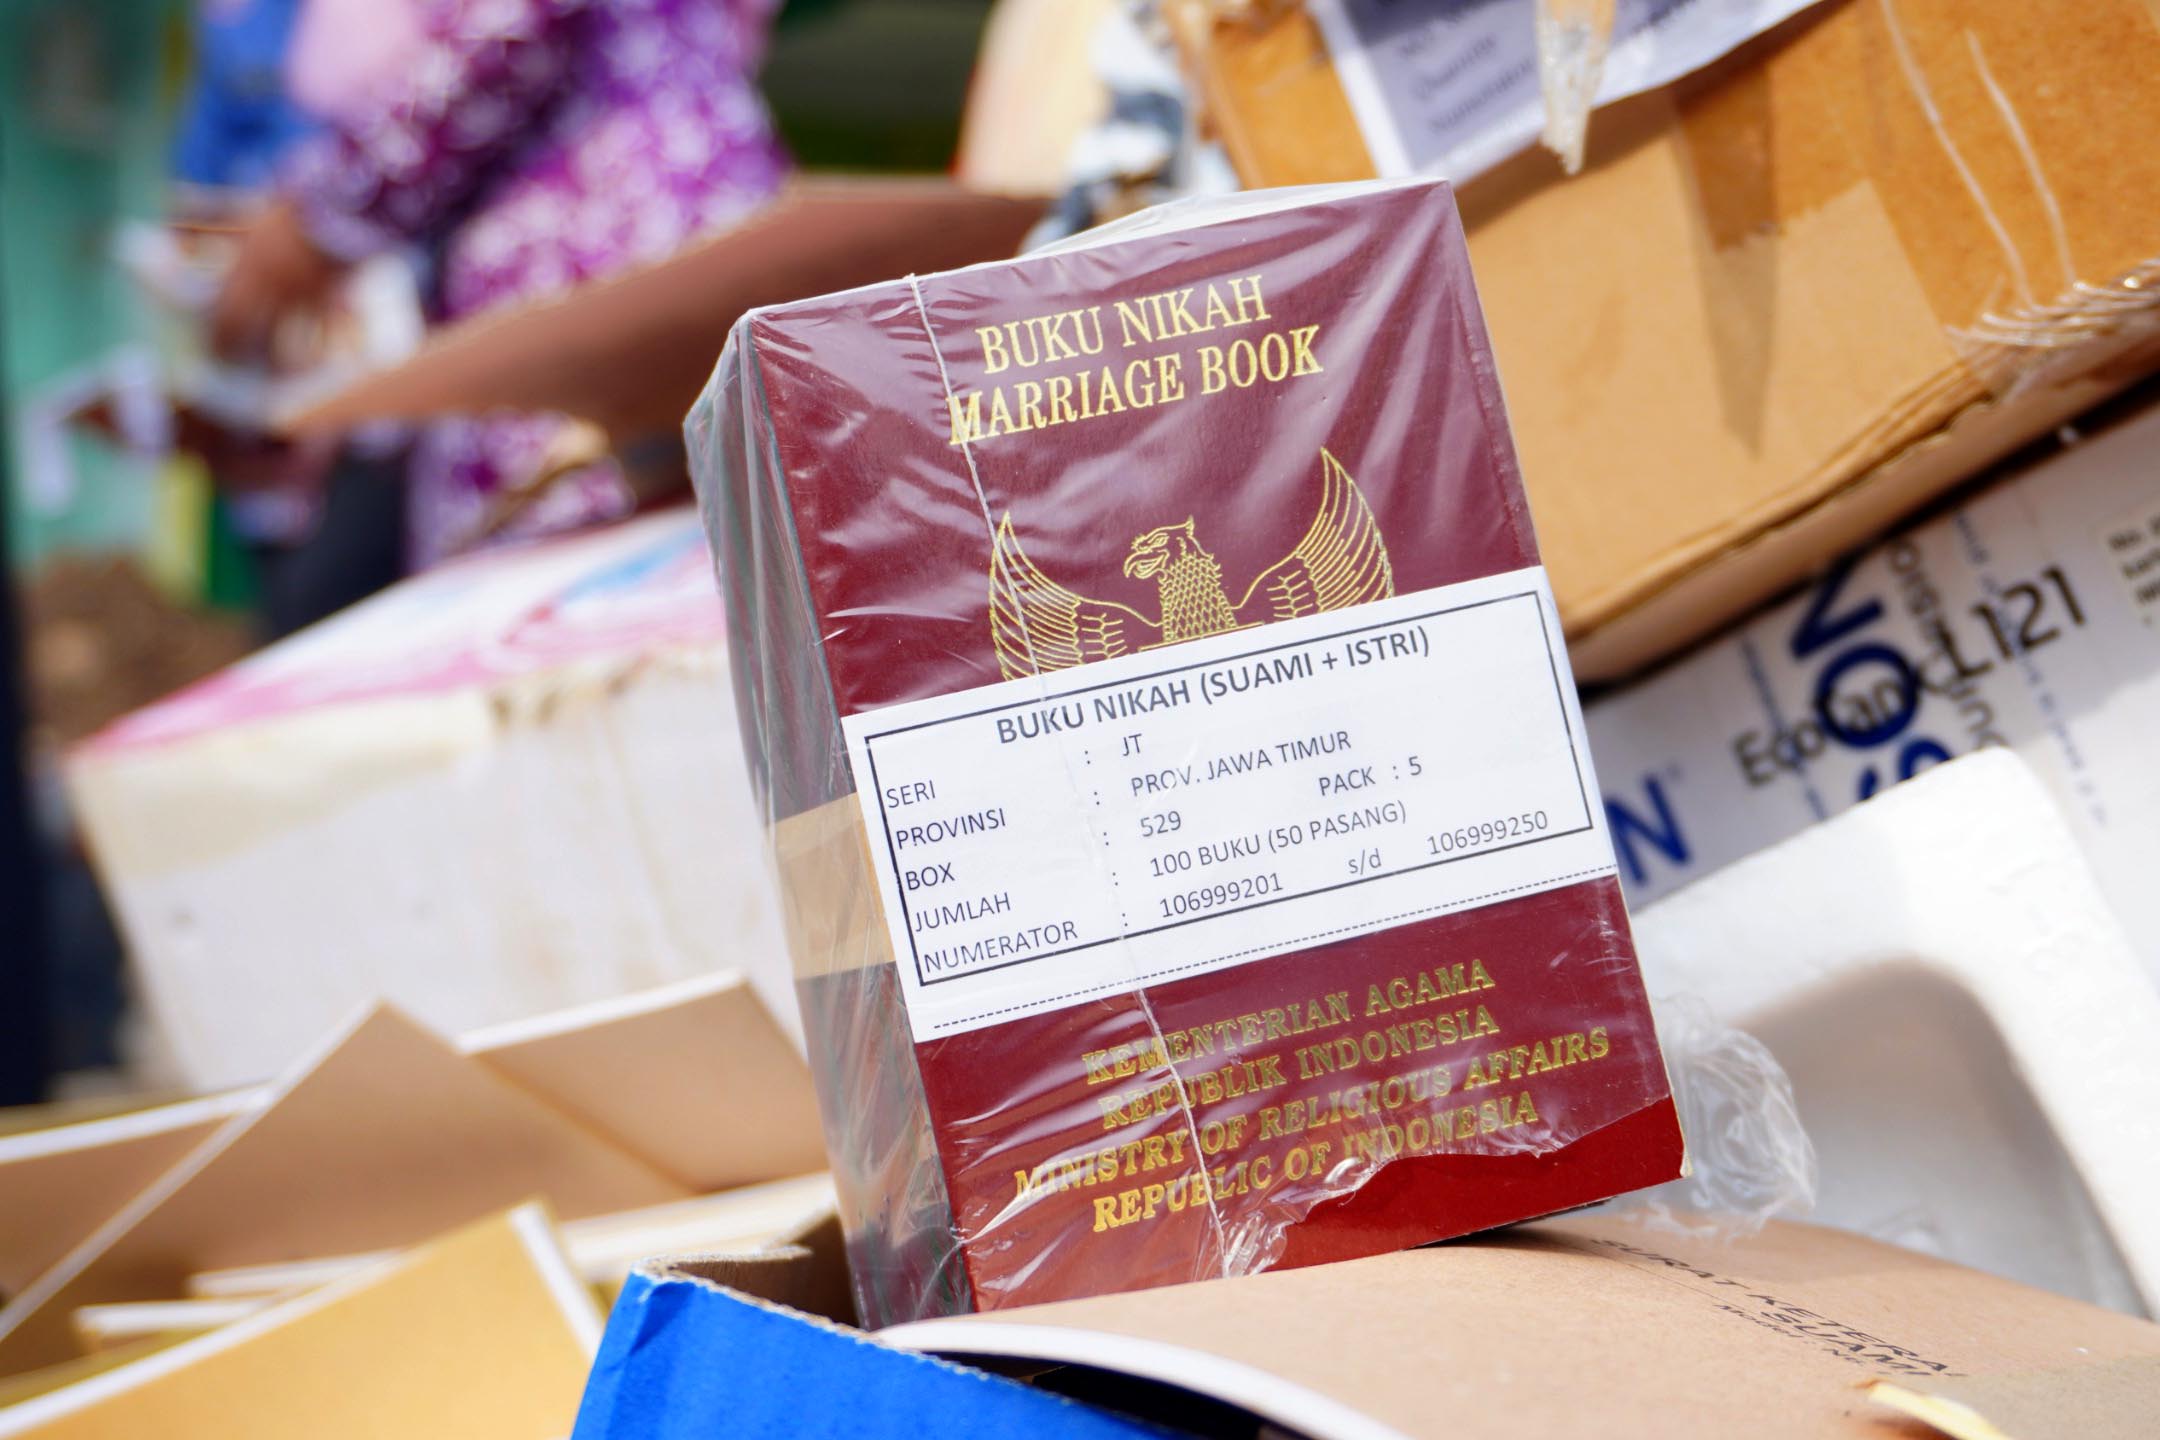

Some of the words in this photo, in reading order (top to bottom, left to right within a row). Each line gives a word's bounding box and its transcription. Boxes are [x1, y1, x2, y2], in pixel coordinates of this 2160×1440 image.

[946, 355, 1184, 445] MARRIAGE
[1199, 325, 1323, 394] BOOK
[975, 307, 1104, 374] BUKU
[1114, 275, 1271, 347] NIKAH
[1934, 563, 2087, 678] L121
[997, 702, 1084, 744] BUKU
[1094, 680, 1191, 721] NIKAH
[1201, 652, 1313, 704] (SUAMI
[1347, 627, 1430, 667] ISTRI)
[887, 780, 936, 807] SERI
[1122, 733, 1143, 757] JT
[896, 808, 1006, 849] PROVINSI
[1131, 767, 1200, 797] PROV.
[1207, 749, 1272, 781] JAWA
[1276, 730, 1351, 762] TIMUR
[905, 862, 955, 890] BOX
[1140, 811, 1182, 838] 529
[1319, 767, 1376, 796] PACK
[1409, 756, 1422, 776] 5
[916, 893, 1011, 932] JUMLAH
[1150, 851, 1191, 877] 100
[1198, 834, 1260, 867] BUKU
[1268, 825, 1302, 852] (50
[1310, 800, 1407, 841] PASANG)
[924, 921, 1078, 973] NUMERATOR
[1160, 873, 1283, 918] 106999201
[1348, 849, 1382, 876] s/d
[1427, 811, 1548, 855] 106999250
[1082, 992, 1351, 1085] KEMENTERIAN
[1365, 959, 1495, 1017] AGAMA
[1098, 1056, 1287, 1129] REPUBLIK
[1296, 1005, 1499, 1080] INDONESIA
[1014, 1129, 1188, 1198] MINISTRY
[1201, 1115, 1247, 1155] OF
[1259, 1065, 1451, 1140] RELIGIOUS
[1464, 1026, 1609, 1090] AFFAIRS
[1093, 1156, 1272, 1232] REPUBLIC
[1284, 1142, 1331, 1181] OF
[1343, 1091, 1538, 1163] INDONESIA
